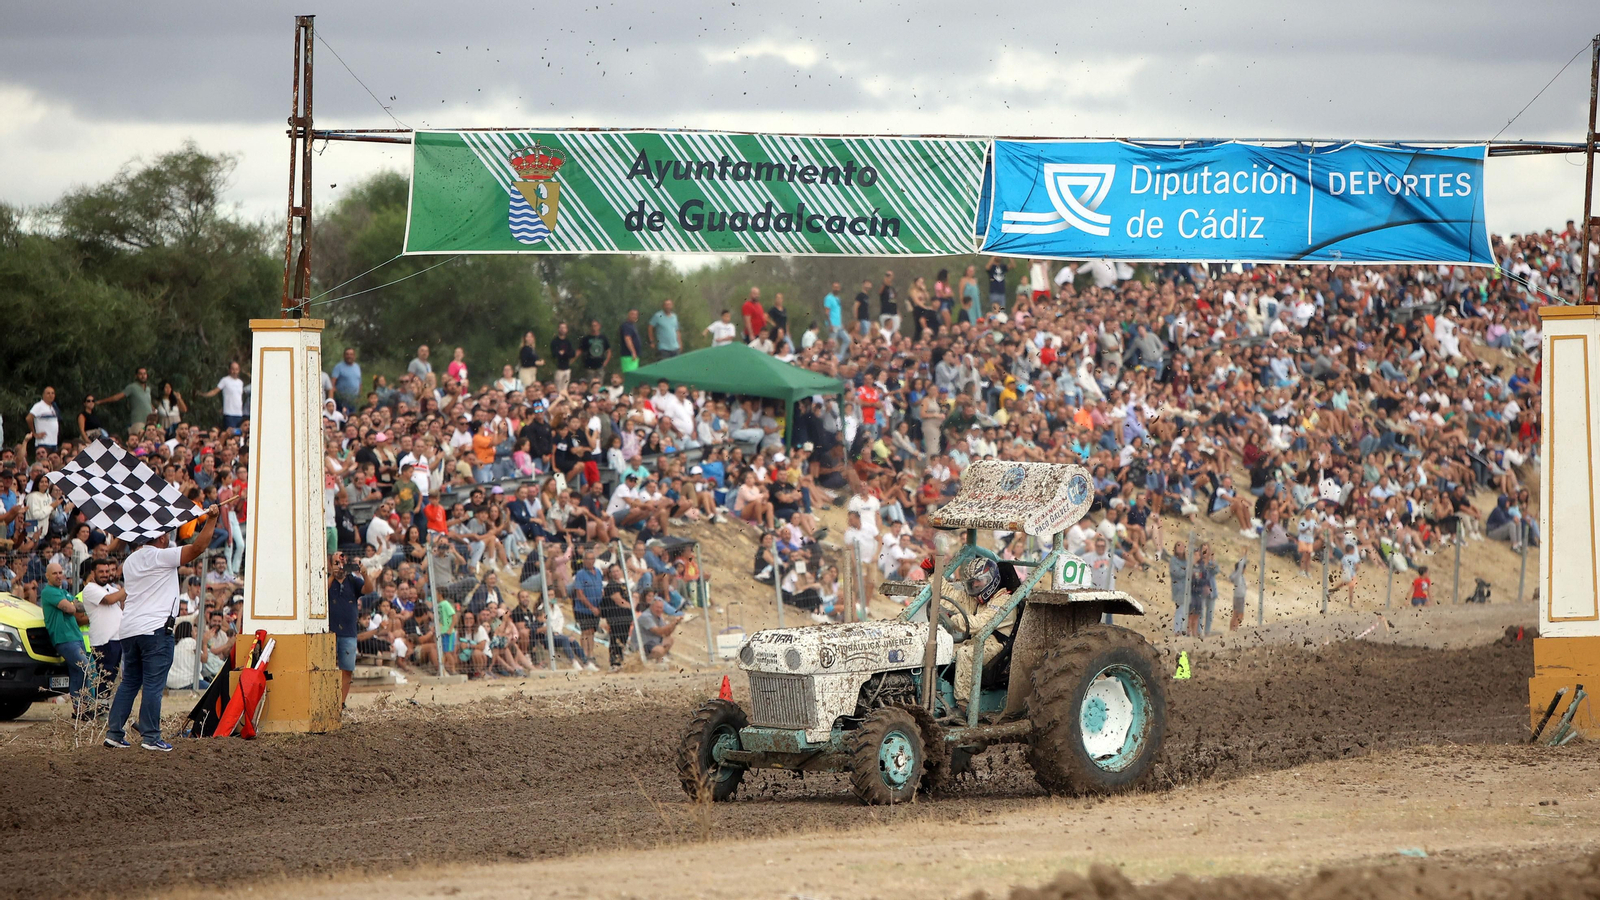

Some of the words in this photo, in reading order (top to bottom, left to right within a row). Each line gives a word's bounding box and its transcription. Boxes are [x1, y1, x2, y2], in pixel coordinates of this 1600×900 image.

[627, 149, 878, 188] Ayuntamiento
[1130, 164, 1298, 200] Diputación
[1329, 170, 1472, 198] DEPORTES
[624, 201, 665, 232] de
[679, 199, 901, 238] Guadalcacín
[1126, 208, 1163, 238] de
[1178, 207, 1265, 239] Cádiz
[1062, 560, 1086, 584] 01
